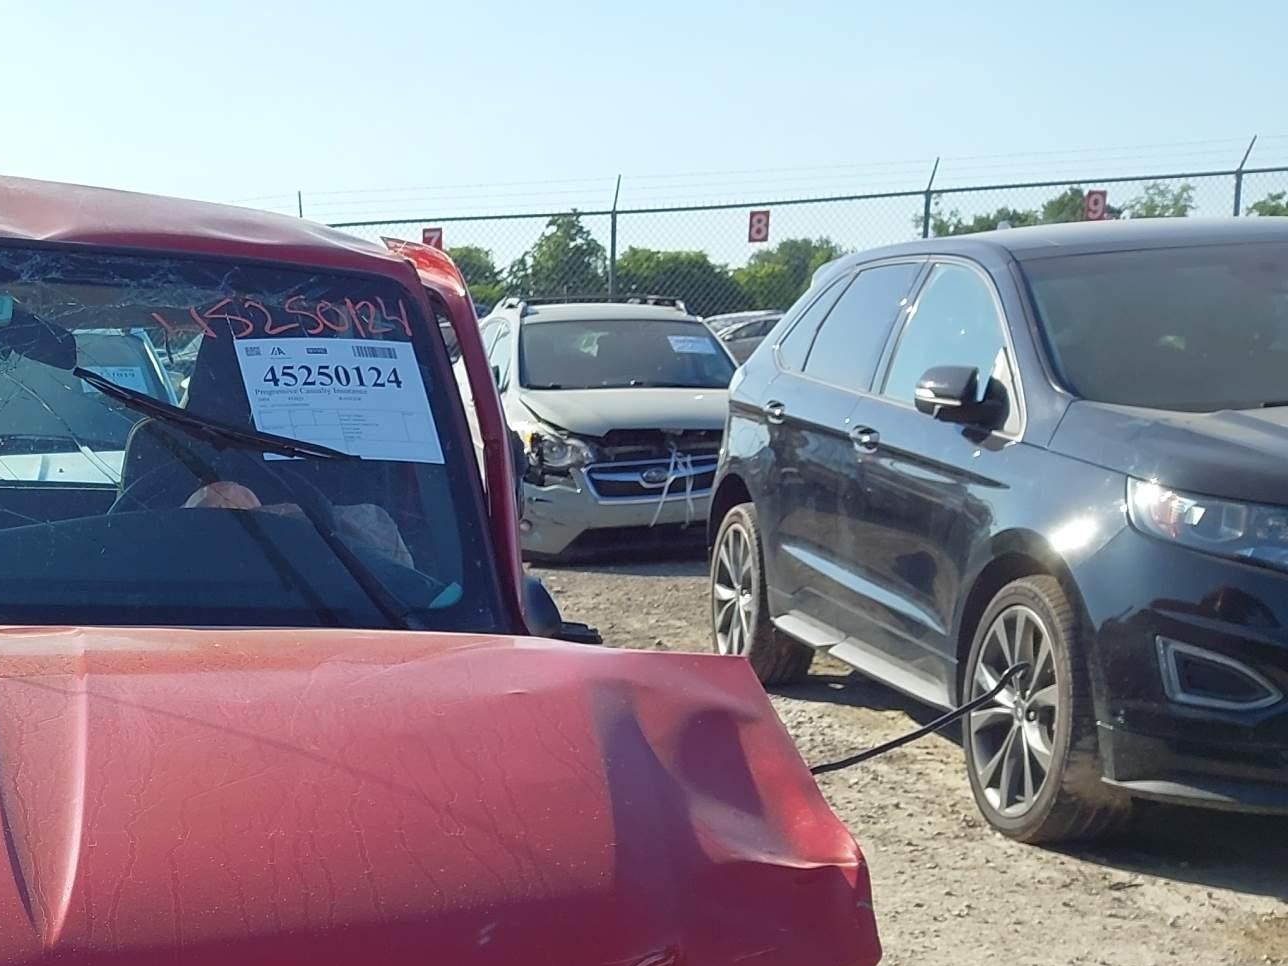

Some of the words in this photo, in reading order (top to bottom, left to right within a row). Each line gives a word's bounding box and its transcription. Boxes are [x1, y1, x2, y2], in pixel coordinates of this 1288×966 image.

[1088, 193, 1105, 219] 9
[424, 231, 441, 248] 7
[750, 213, 768, 240] 8
[263, 364, 403, 390] 45250124
